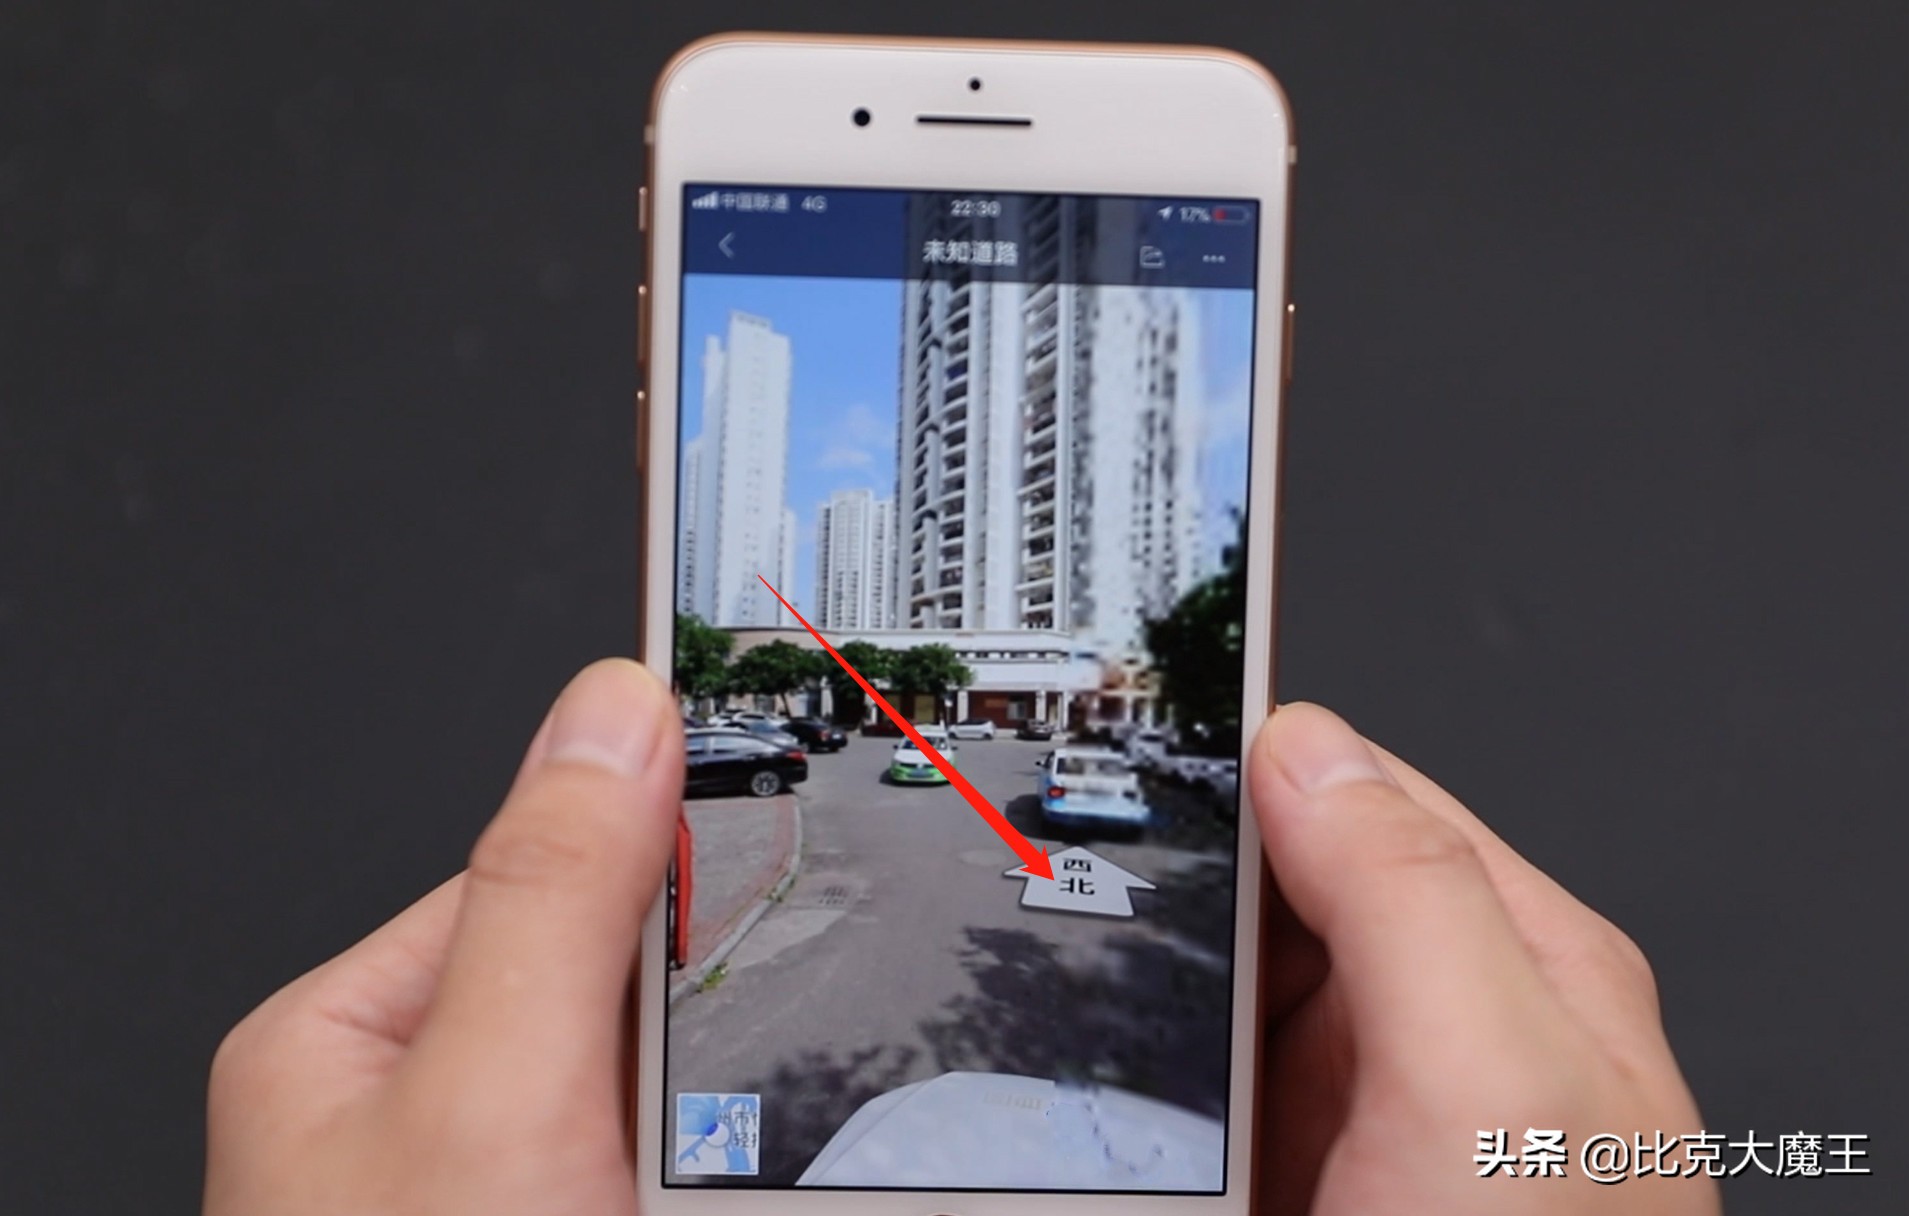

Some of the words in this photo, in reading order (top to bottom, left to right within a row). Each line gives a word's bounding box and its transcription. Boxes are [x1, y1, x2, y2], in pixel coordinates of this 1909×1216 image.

[720, 192, 789, 212] 中国联通
[801, 195, 827, 213] 4G
[950, 199, 1001, 217] 22:30
[1180, 206, 1211, 223] 17%
[922, 239, 1018, 266] 未知道路
[1060, 858, 1095, 896] 西北
